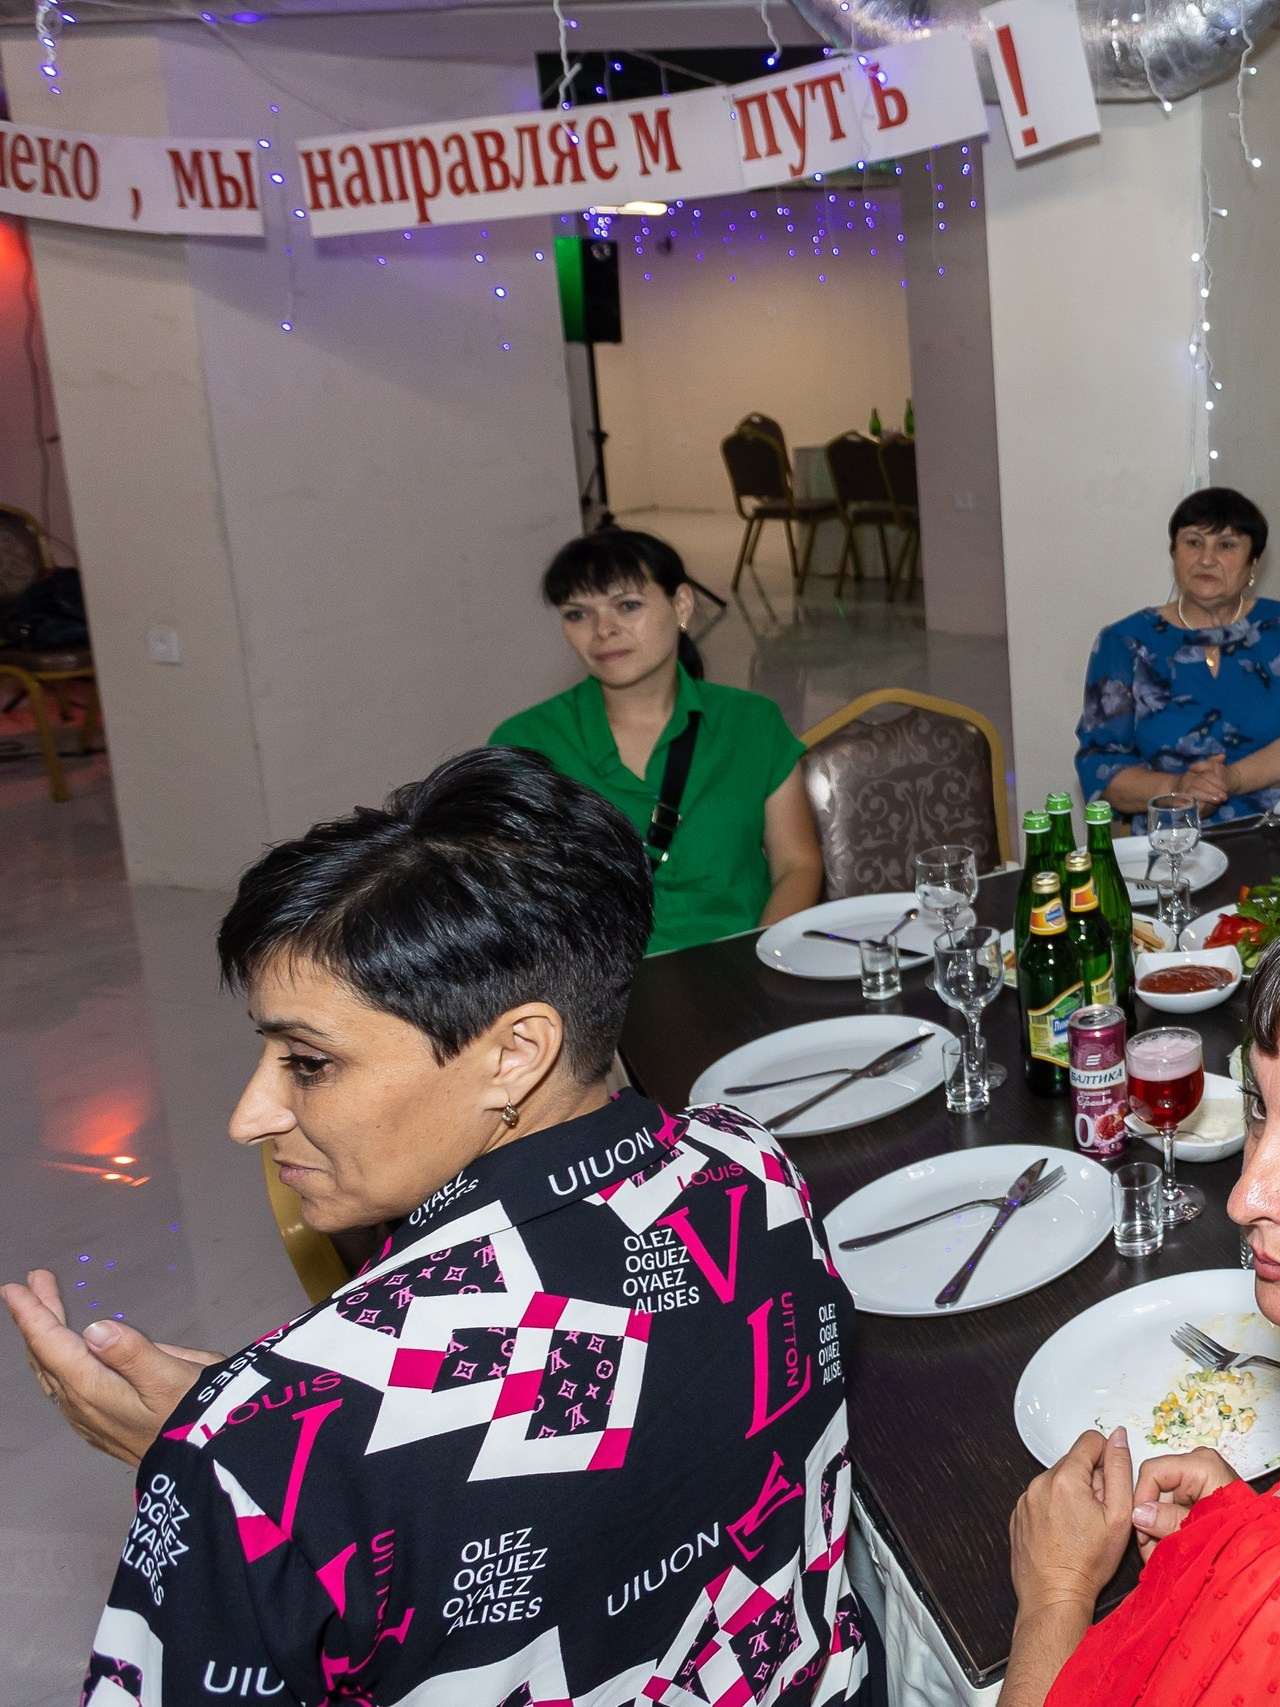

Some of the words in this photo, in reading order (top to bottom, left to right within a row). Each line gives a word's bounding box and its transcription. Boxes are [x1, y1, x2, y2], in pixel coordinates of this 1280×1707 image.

[169, 148, 259, 211] мы
[1071, 1068, 1123, 1085] БАЛТИКА
[548, 1126, 655, 1196] UIUON
[677, 1162, 744, 1191] LOUIS
[623, 1228, 676, 1252] OLEZ
[625, 1245, 690, 1273] OGUEZ
[622, 1267, 687, 1297] OYAEZ
[634, 1286, 700, 1316] ALISES
[781, 1291, 799, 1387] UITTON
[822, 1360, 843, 1386] ALISE
[199, 1371, 342, 1441] LOUIS
[151, 1473, 190, 1532] OLEZ
[130, 1515, 168, 1577] YAEZ
[461, 1527, 533, 1563] OLEZ
[453, 1548, 548, 1591] OGUEZ
[606, 1521, 720, 1616] UIUON
[442, 1575, 533, 1618] OYAEZ
[446, 1596, 543, 1636] ALISES
[203, 1660, 285, 1697] UIU
